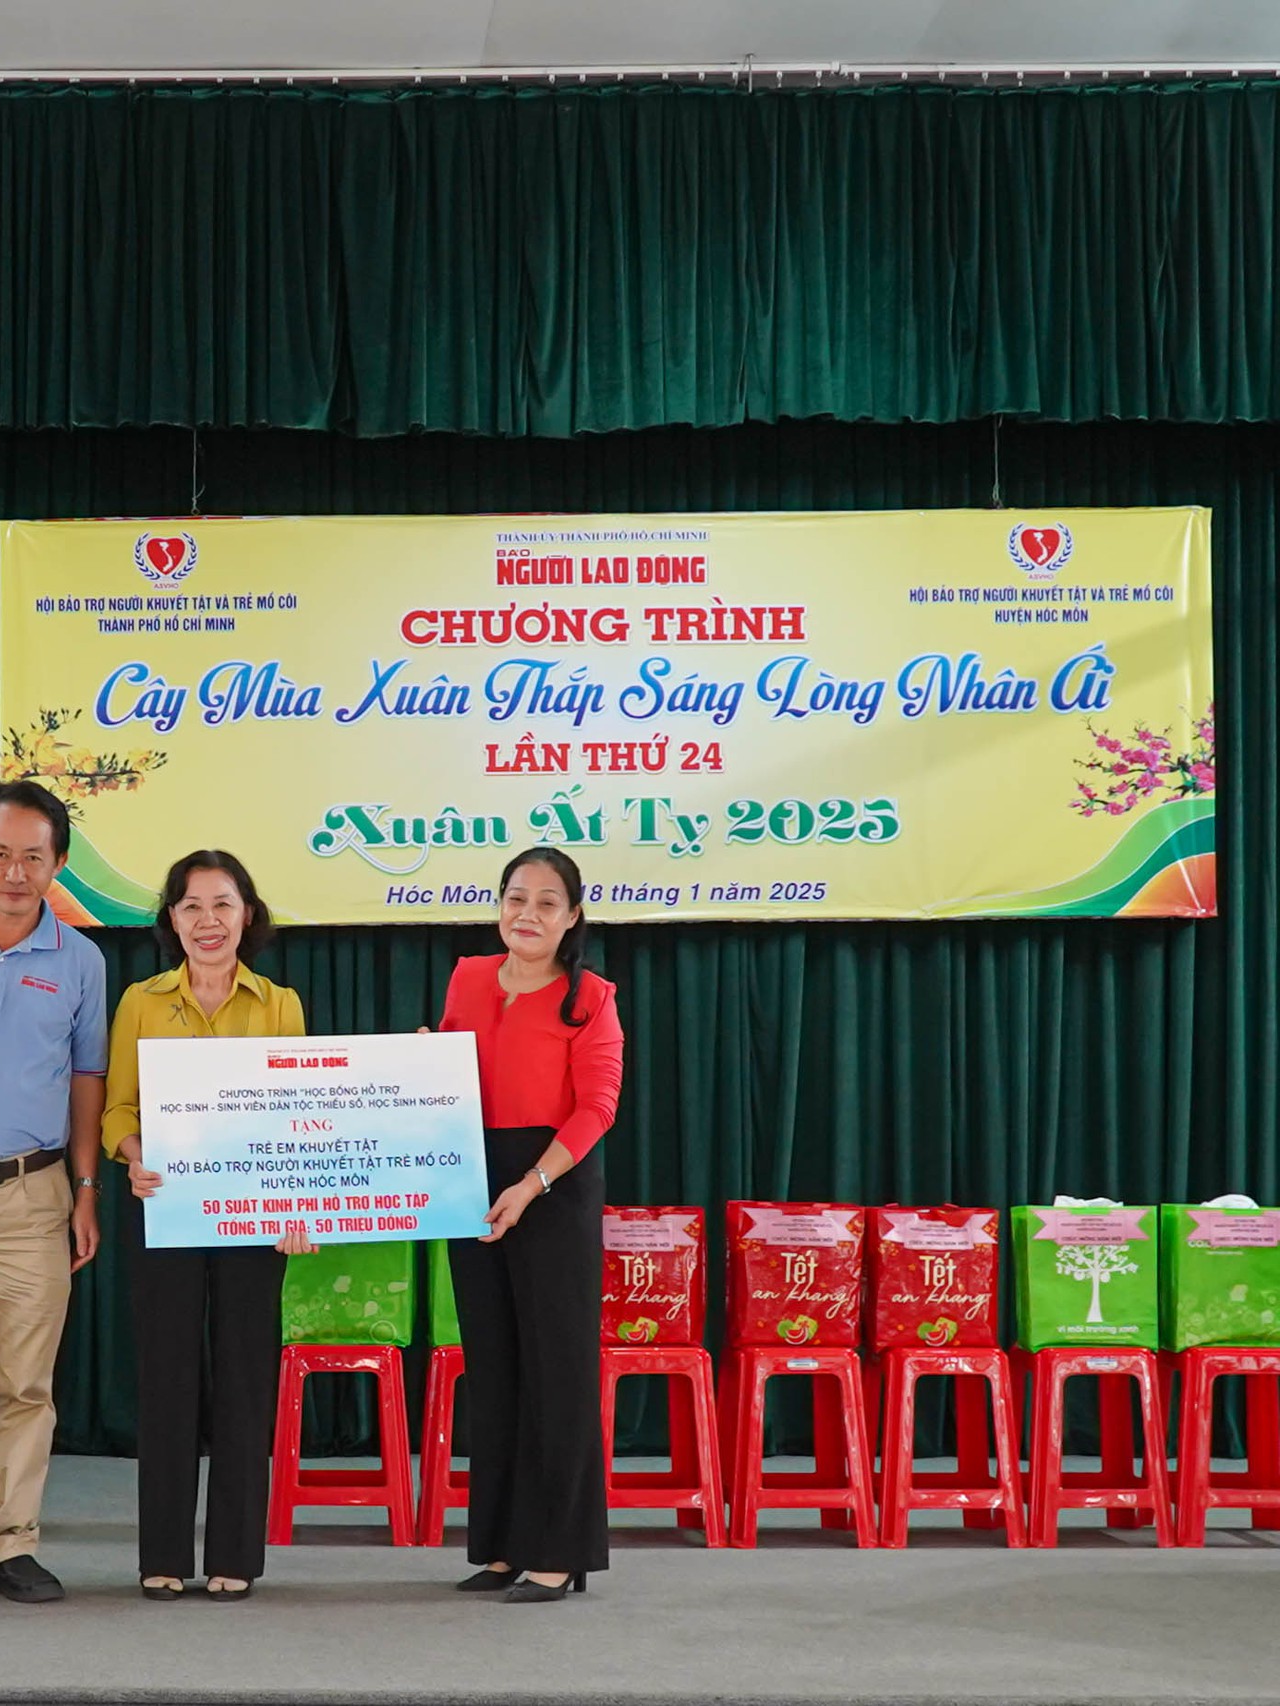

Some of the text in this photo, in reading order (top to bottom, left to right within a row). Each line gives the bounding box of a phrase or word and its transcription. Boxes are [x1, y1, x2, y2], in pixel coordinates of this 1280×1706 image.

[496, 553, 706, 585] NGƯỜI LAO ĐỘNG
[35, 591, 298, 616] HỘI BẢO TRỢ NGƯỜI KHUYẾT TẬT VÀ TRẺ MỒ CÔI
[909, 583, 1174, 605] HỘI BẢO TRỢ NGƯỜI KHUYẾT TẬT VÀ TRẺ MỒ CÔI
[98, 613, 236, 632] THÀNH PHỐ HỒ CHÍ MINH
[401, 596, 807, 644] CHƯƠNG TRÌNH
[994, 606, 1089, 626] HUYỆN HÓC MÔN
[96, 644, 1117, 732] Cây Mùa Xuân Thắp Sáng Lòng Nhân Ái
[485, 732, 723, 773] LẦN THỨ 24
[309, 783, 901, 874] Xuân Ất Tỵ 2025
[386, 885, 499, 906] Hóc Môn,
[579, 881, 827, 906] 18 tháng 1 năm 2025
[379, 1085, 401, 1097] TRỢ
[185, 1101, 209, 1113] SINH
[217, 1101, 241, 1112] SINH
[368, 1097, 390, 1110] HỌC
[393, 1096, 417, 1108] SINH
[289, 1117, 334, 1136] TẶNG
[247, 1139, 379, 1155] TRẺ EM KHUYẾT TẬT
[167, 1152, 462, 1176] HỘI BẢO TRỢ NGƯỜI KHUYẾT TẬT TRẺ MỒ CÔI
[261, 1173, 370, 1192] HUYỆN HÓC MÔN
[202, 1200, 221, 1216] 50
[262, 1198, 293, 1214] KINH
[344, 1195, 372, 1212] TRỢ
[374, 1195, 401, 1212] HỌC
[404, 1192, 430, 1210] TẬP
[315, 1218, 333, 1234] 50
[617, 1252, 657, 1287] Tết
[780, 1250, 819, 1285] Tết
[919, 1252, 958, 1287] Tết
[624, 1286, 690, 1320] khang
[751, 1284, 850, 1320] an khang
[891, 1286, 992, 1320] an khang
